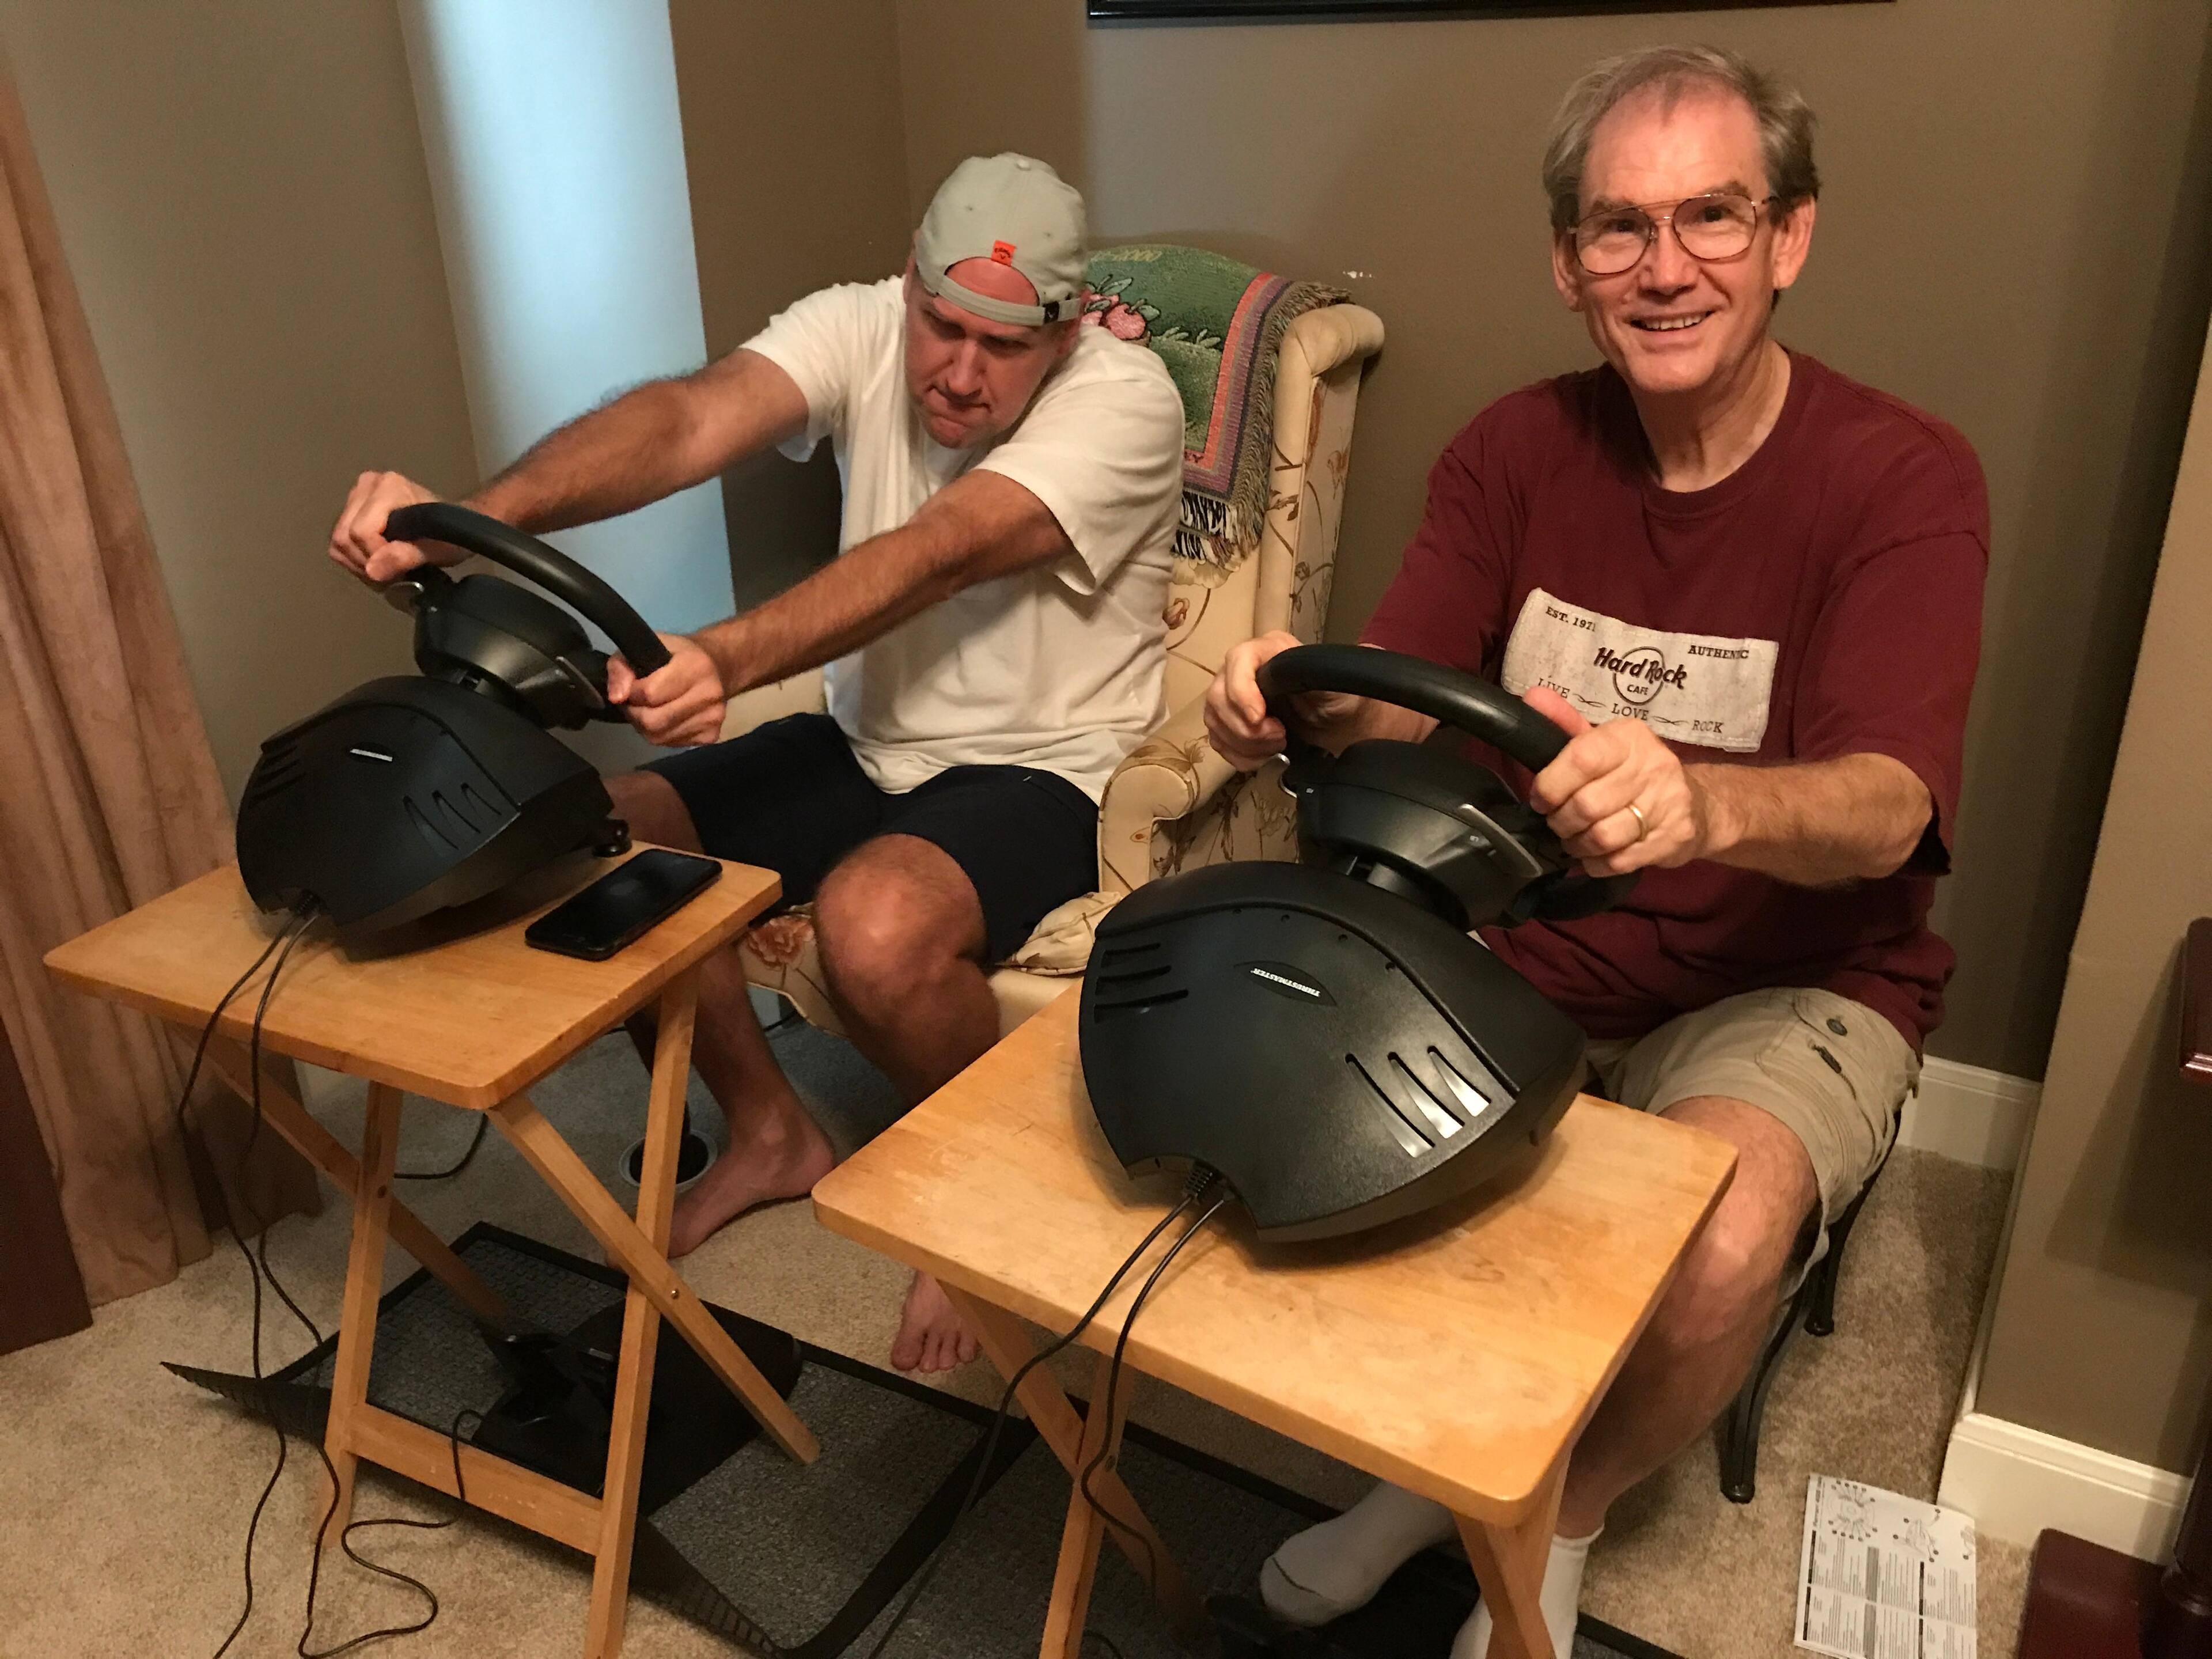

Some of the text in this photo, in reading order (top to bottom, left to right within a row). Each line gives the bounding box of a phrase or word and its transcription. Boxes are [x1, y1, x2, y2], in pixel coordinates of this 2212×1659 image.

[1546, 606, 1596, 632] EST. 1971
[1688, 645, 1749, 659] AUTHENC
[1593, 647, 1687, 690] Hard Rock
[1627, 684, 1649, 695] CAFE
[1538, 677, 1724, 733] LIVE LOVE ROCK
[1253, 968, 1321, 997] THRUSTMASTER
